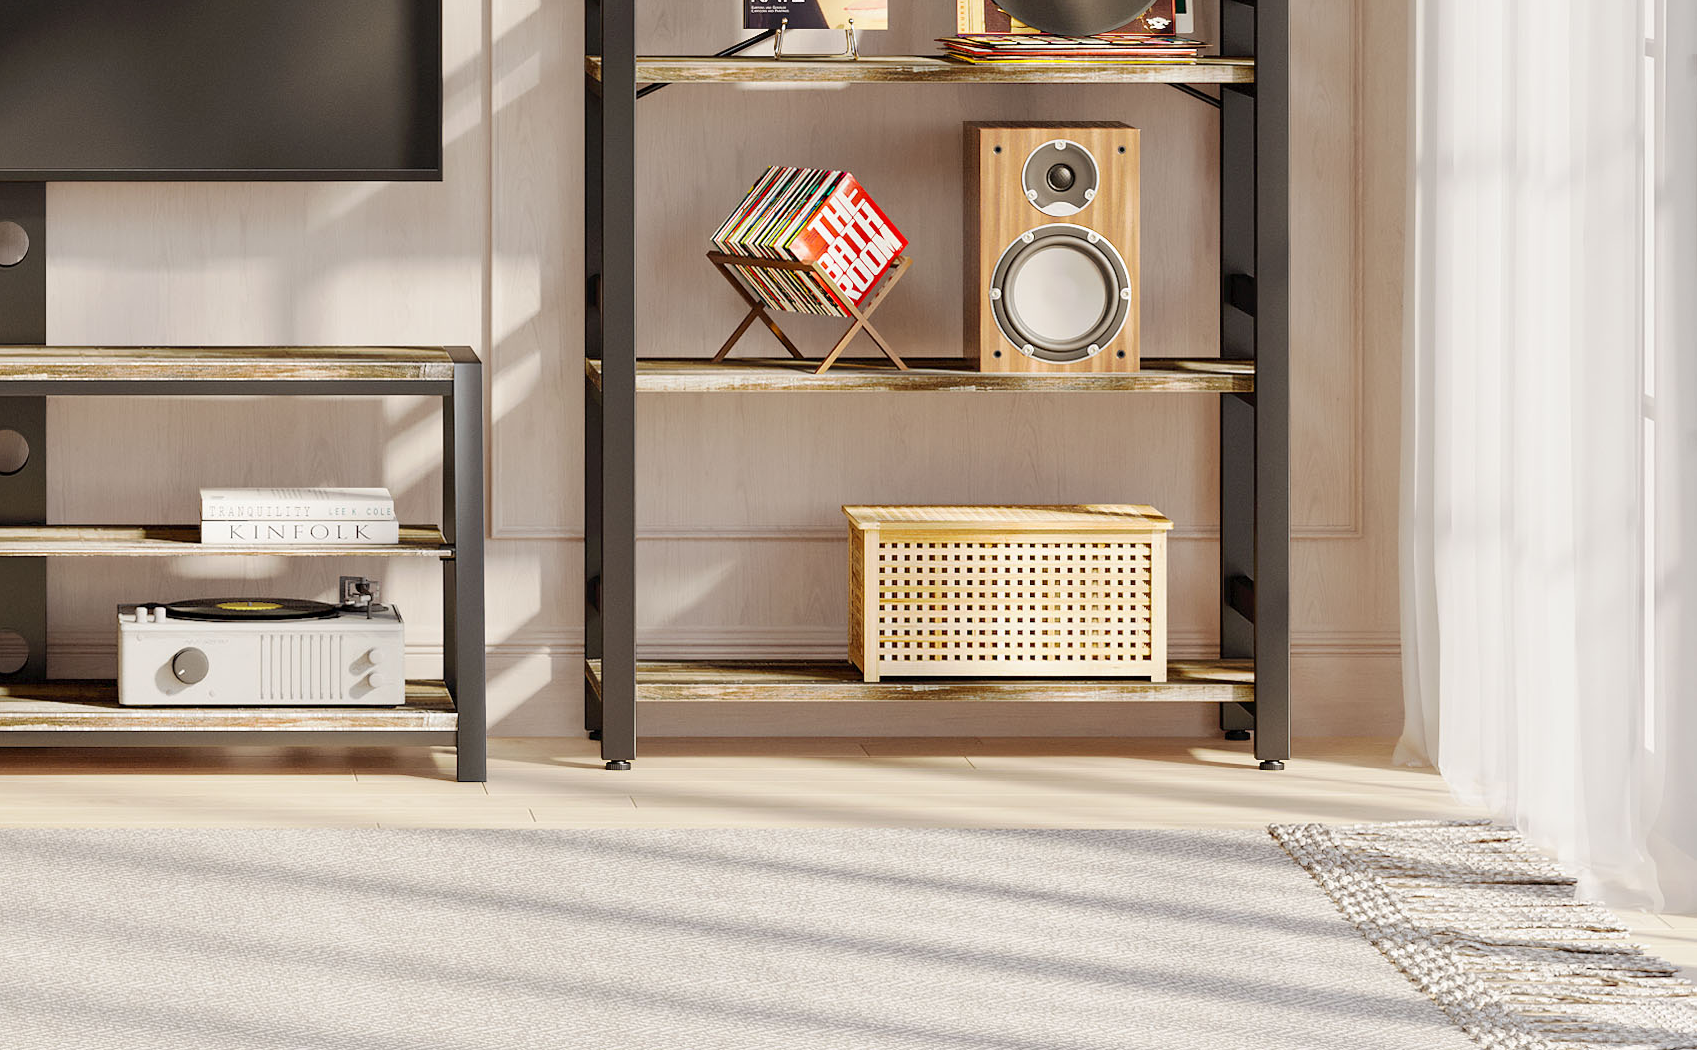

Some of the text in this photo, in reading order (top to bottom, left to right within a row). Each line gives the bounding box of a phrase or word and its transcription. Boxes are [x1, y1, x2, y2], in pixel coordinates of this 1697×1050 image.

[807, 179, 859, 246] THE
[816, 198, 884, 281] BATH
[836, 223, 903, 306] ROOM
[208, 505, 311, 518] TRANQUILITY
[229, 524, 372, 540] KINFOLK
[328, 507, 392, 516] LEE K COLE
